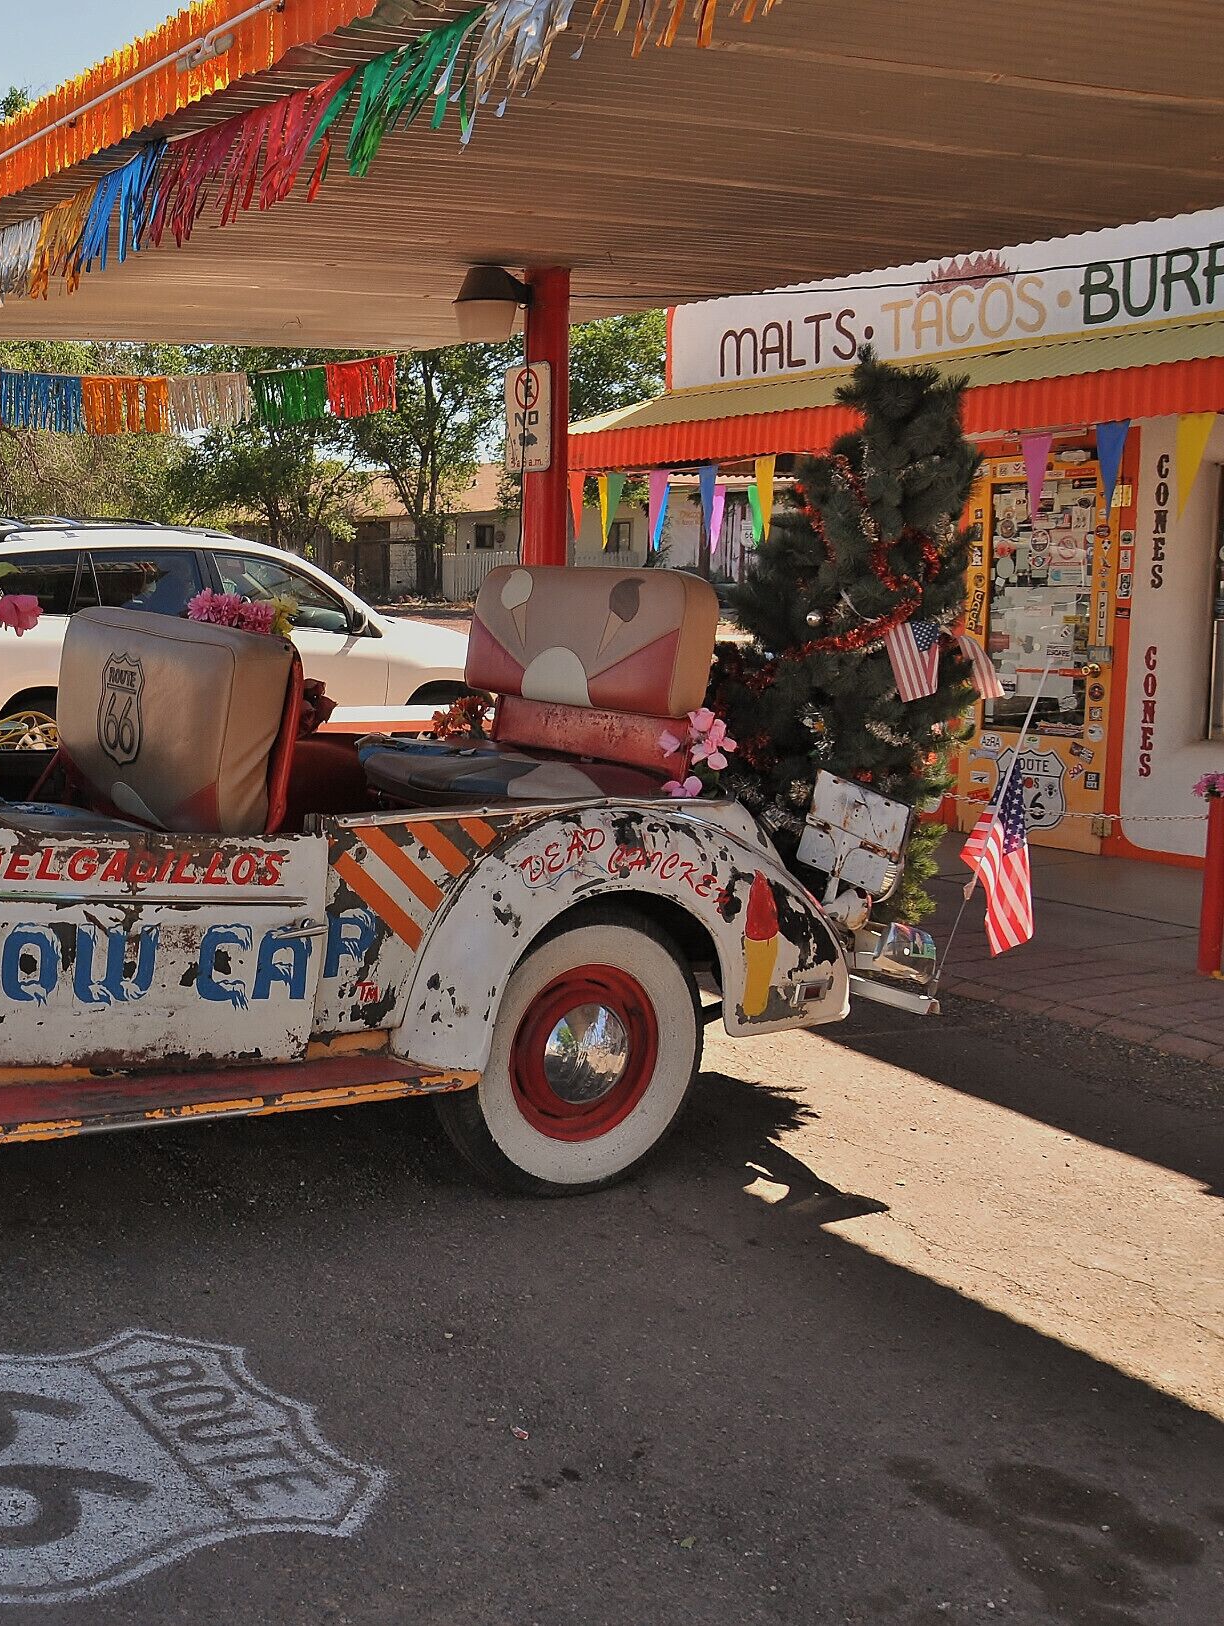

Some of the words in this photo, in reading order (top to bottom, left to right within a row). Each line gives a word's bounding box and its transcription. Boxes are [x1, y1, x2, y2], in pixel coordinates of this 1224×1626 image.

[719, 309, 857, 378] MALTS
[880, 275, 1048, 352] TACOS
[514, 410, 539, 427] NO
[1150, 453, 1170, 589] CONES
[1097, 601, 1106, 637] PULL
[108, 666, 137, 687] ROUTE
[104, 692, 134, 755] 66
[1138, 645, 1158, 777] CONES
[1019, 758, 1050, 773] OUTE
[519, 827, 606, 883] DEAD
[195, 907, 377, 1011] CAP
[355, 981, 380, 1004] TM
[109, 1358, 328, 1503] ROUTE
